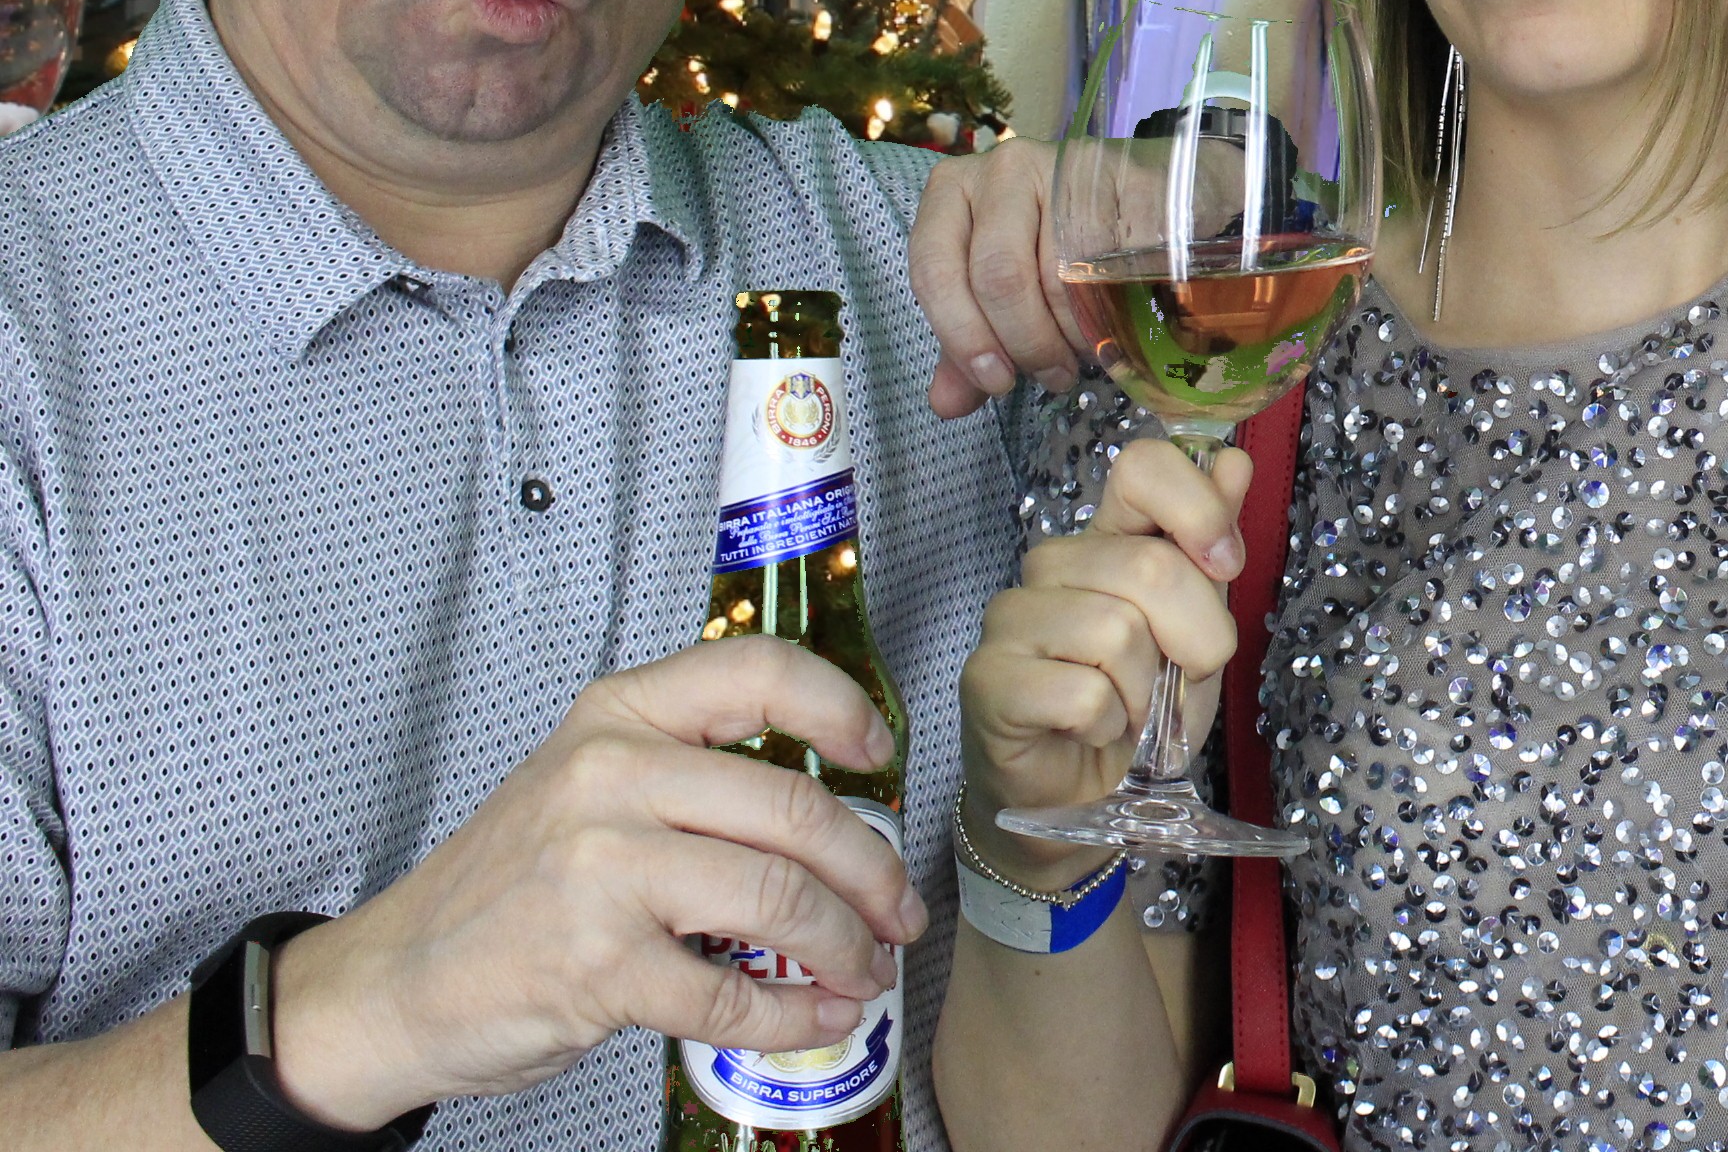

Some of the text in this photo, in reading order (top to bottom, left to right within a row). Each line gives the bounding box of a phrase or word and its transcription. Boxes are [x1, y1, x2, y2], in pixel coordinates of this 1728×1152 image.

[768, 386, 832, 435] BIRRA PERONI
[788, 436, 817, 446] 1846
[752, 496, 824, 523] ITALIANA
[825, 485, 854, 501] ORIG
[721, 548, 749, 562] TUTTI
[752, 524, 836, 554] INGREDIENTI
[731, 1059, 878, 1102] BIRRA SUPERIORE
